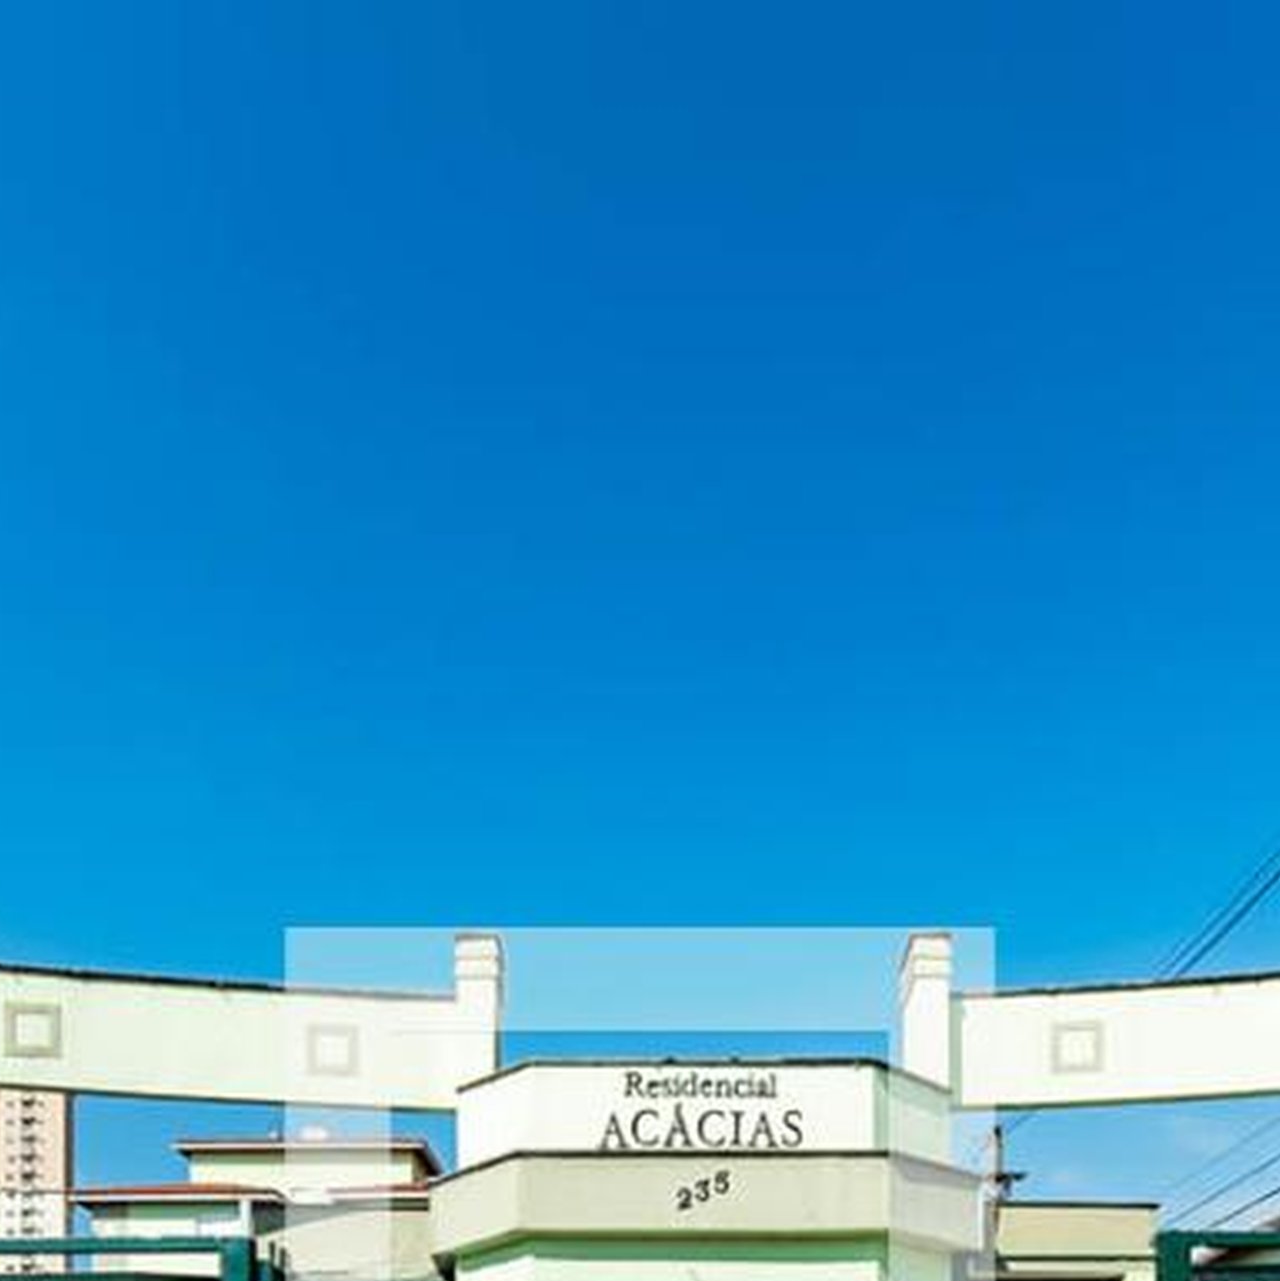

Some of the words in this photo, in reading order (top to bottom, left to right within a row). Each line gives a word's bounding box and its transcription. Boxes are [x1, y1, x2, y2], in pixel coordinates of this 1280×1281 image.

[624, 1070, 777, 1099] Residencial
[597, 1102, 804, 1152] ACÁCIAS
[676, 1170, 730, 1210] 235
